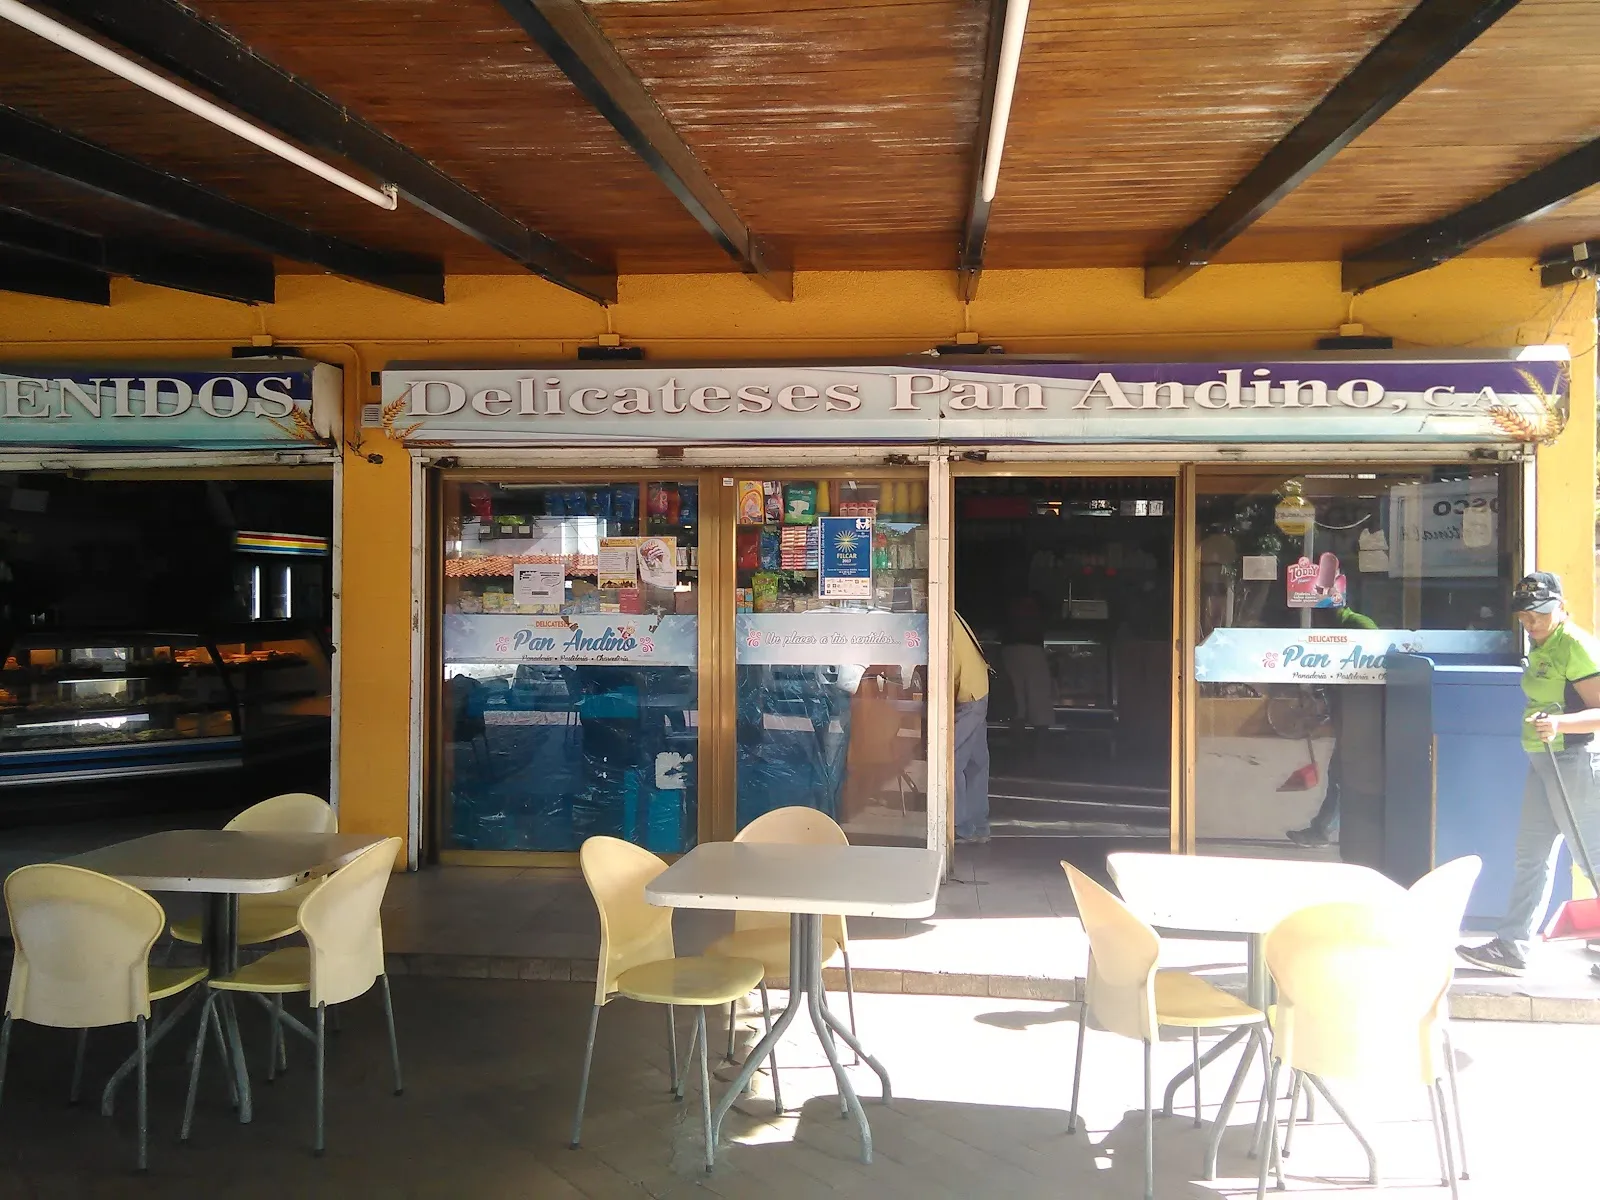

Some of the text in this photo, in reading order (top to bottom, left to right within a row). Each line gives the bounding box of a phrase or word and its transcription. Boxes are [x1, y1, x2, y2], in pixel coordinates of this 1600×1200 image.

[0, 376, 298, 419] ENIDOS
[404, 376, 862, 416] Delicateses
[888, 373, 1049, 412] Pan
[1072, 367, 1408, 415] Andino,
[535, 620, 570, 628] DELICATESE
[513, 626, 638, 652] Pan Andino
[765, 631, 781, 645] Un
[783, 630, 818, 647] placer
[819, 636, 828, 645] a
[1308, 635, 1348, 643] DELICATESES
[1282, 644, 1332, 668] Pan
